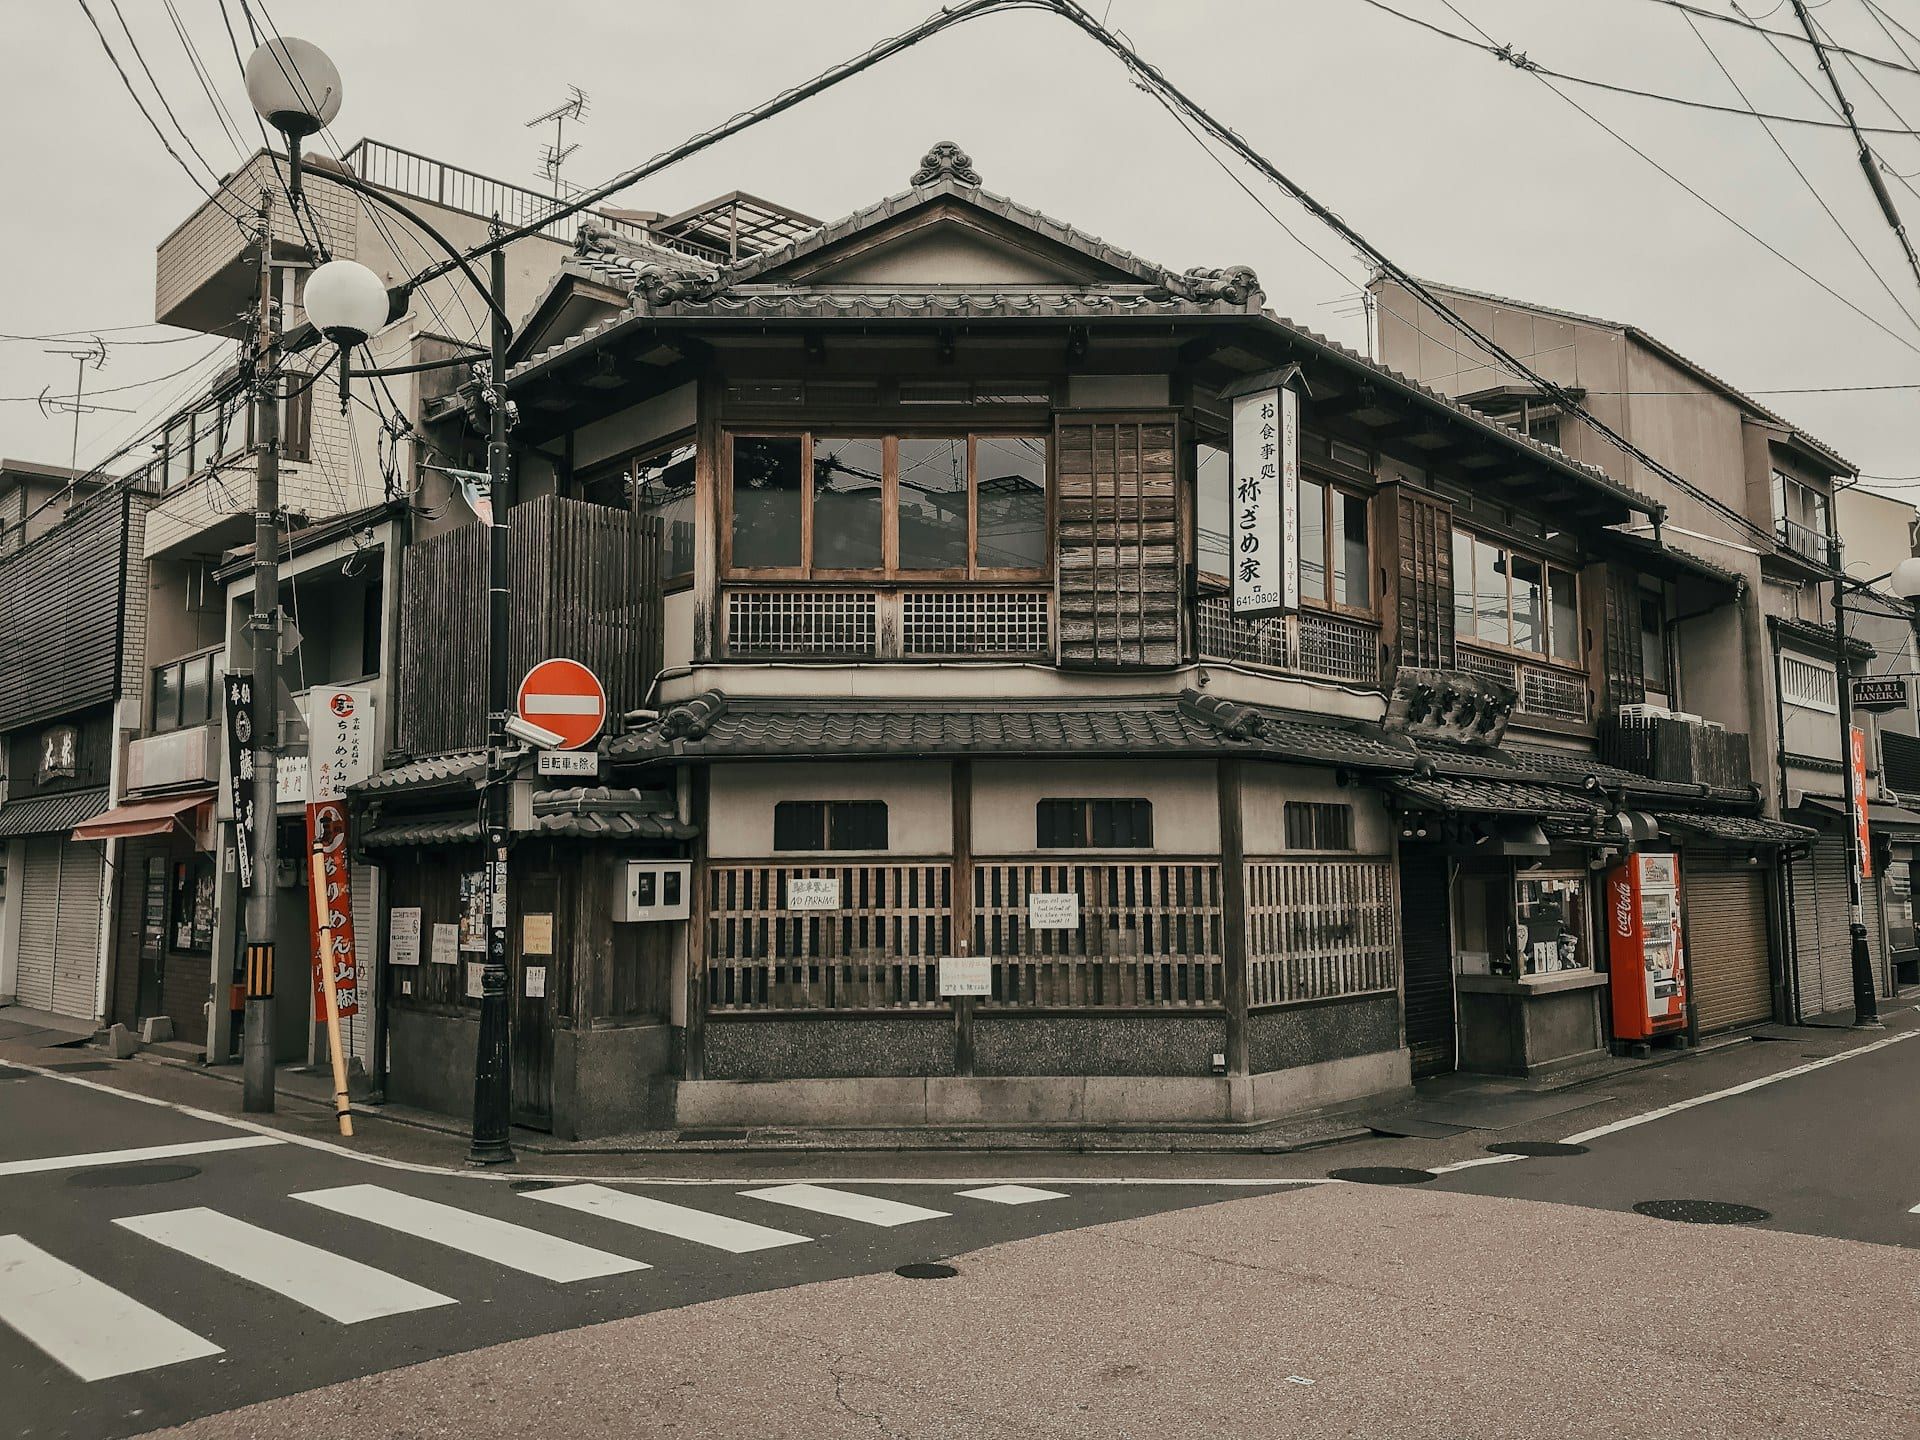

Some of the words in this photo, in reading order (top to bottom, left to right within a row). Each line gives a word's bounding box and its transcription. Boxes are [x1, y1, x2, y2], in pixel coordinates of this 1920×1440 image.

[1259, 402, 1277, 480] お食事処
[1236, 592, 1278, 607] 641-0802
[1860, 683, 1898, 693] INARI
[1855, 691, 1905, 701] HANEIKAI
[333, 720, 348, 794] ちりめん山椒
[541, 756, 595, 770] 自転車を除く
[319, 763, 330, 796] 専門店
[791, 896, 803, 905] NO
[805, 895, 836, 906] PARKING
[325, 857, 358, 1010] ちりめん山椒
